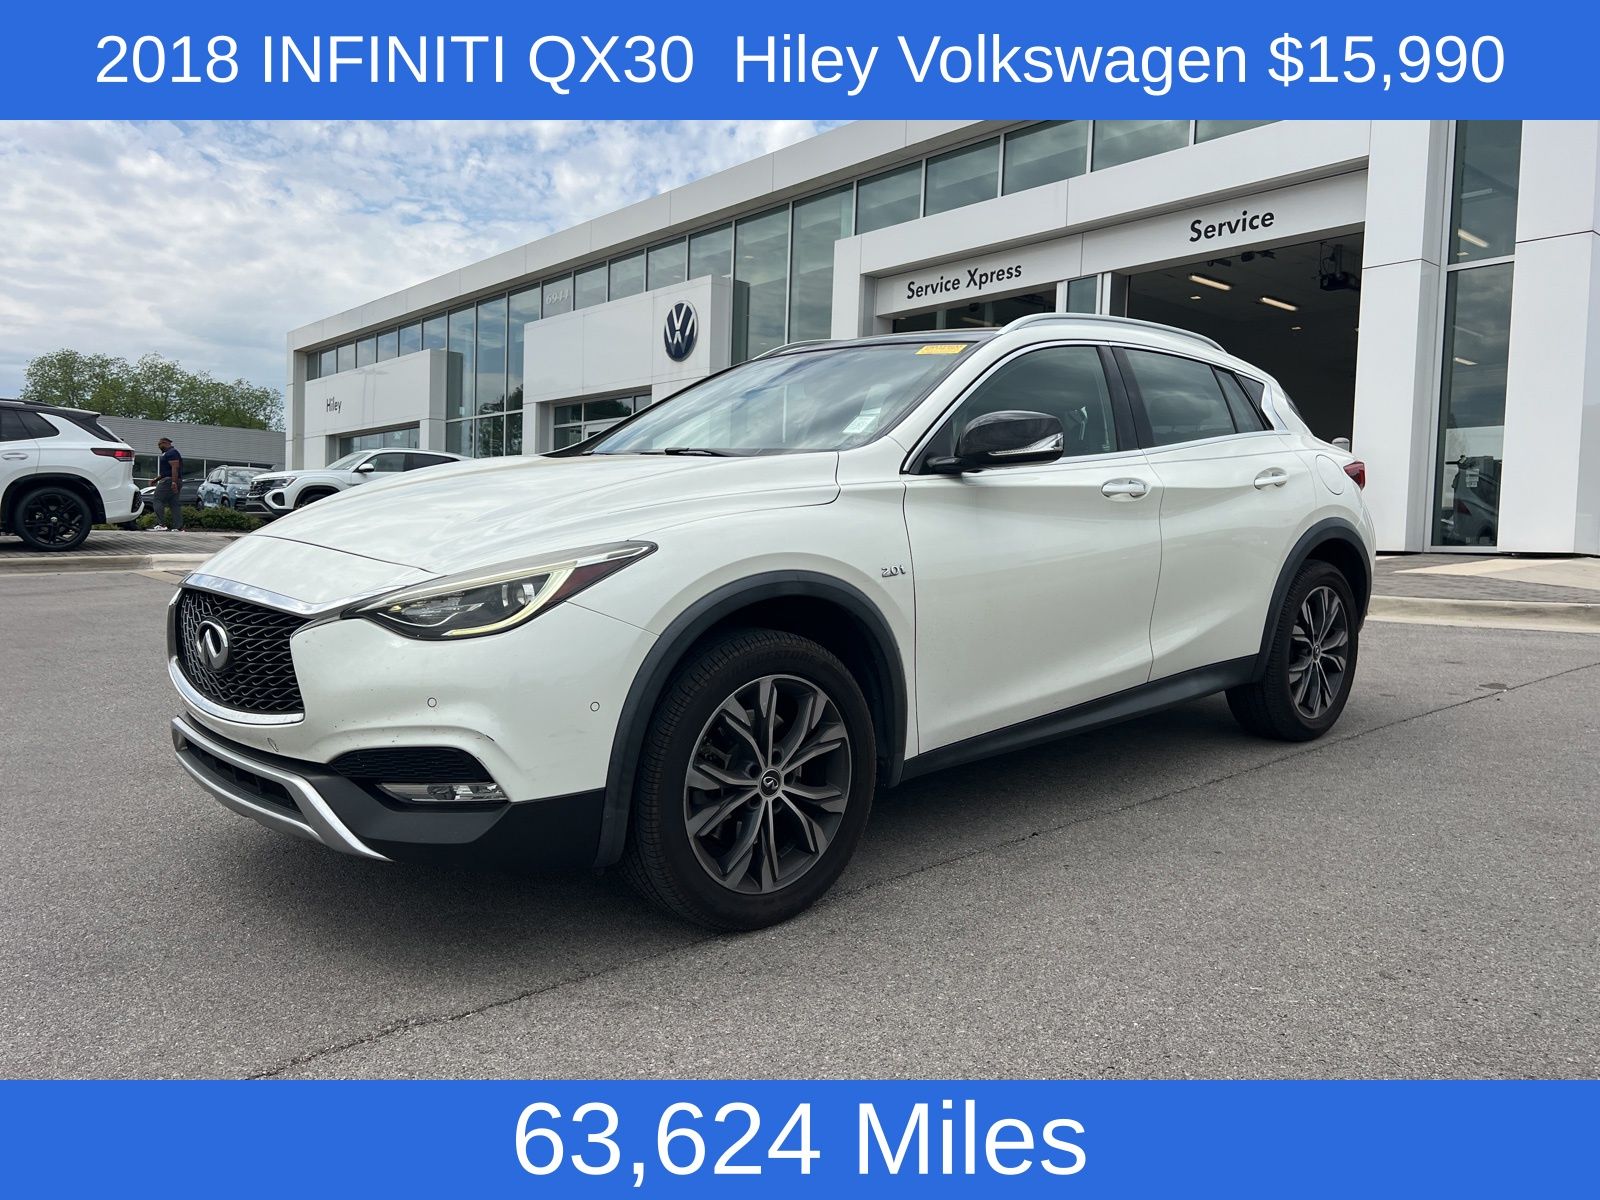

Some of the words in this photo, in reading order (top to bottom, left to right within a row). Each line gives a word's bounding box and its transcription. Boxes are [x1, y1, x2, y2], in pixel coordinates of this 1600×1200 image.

[1189, 210, 1275, 242] Service
[907, 276, 961, 299] Service
[966, 265, 1022, 290] Xpress
[664, 300, 699, 362] VW
[326, 396, 343, 414] Hiley
